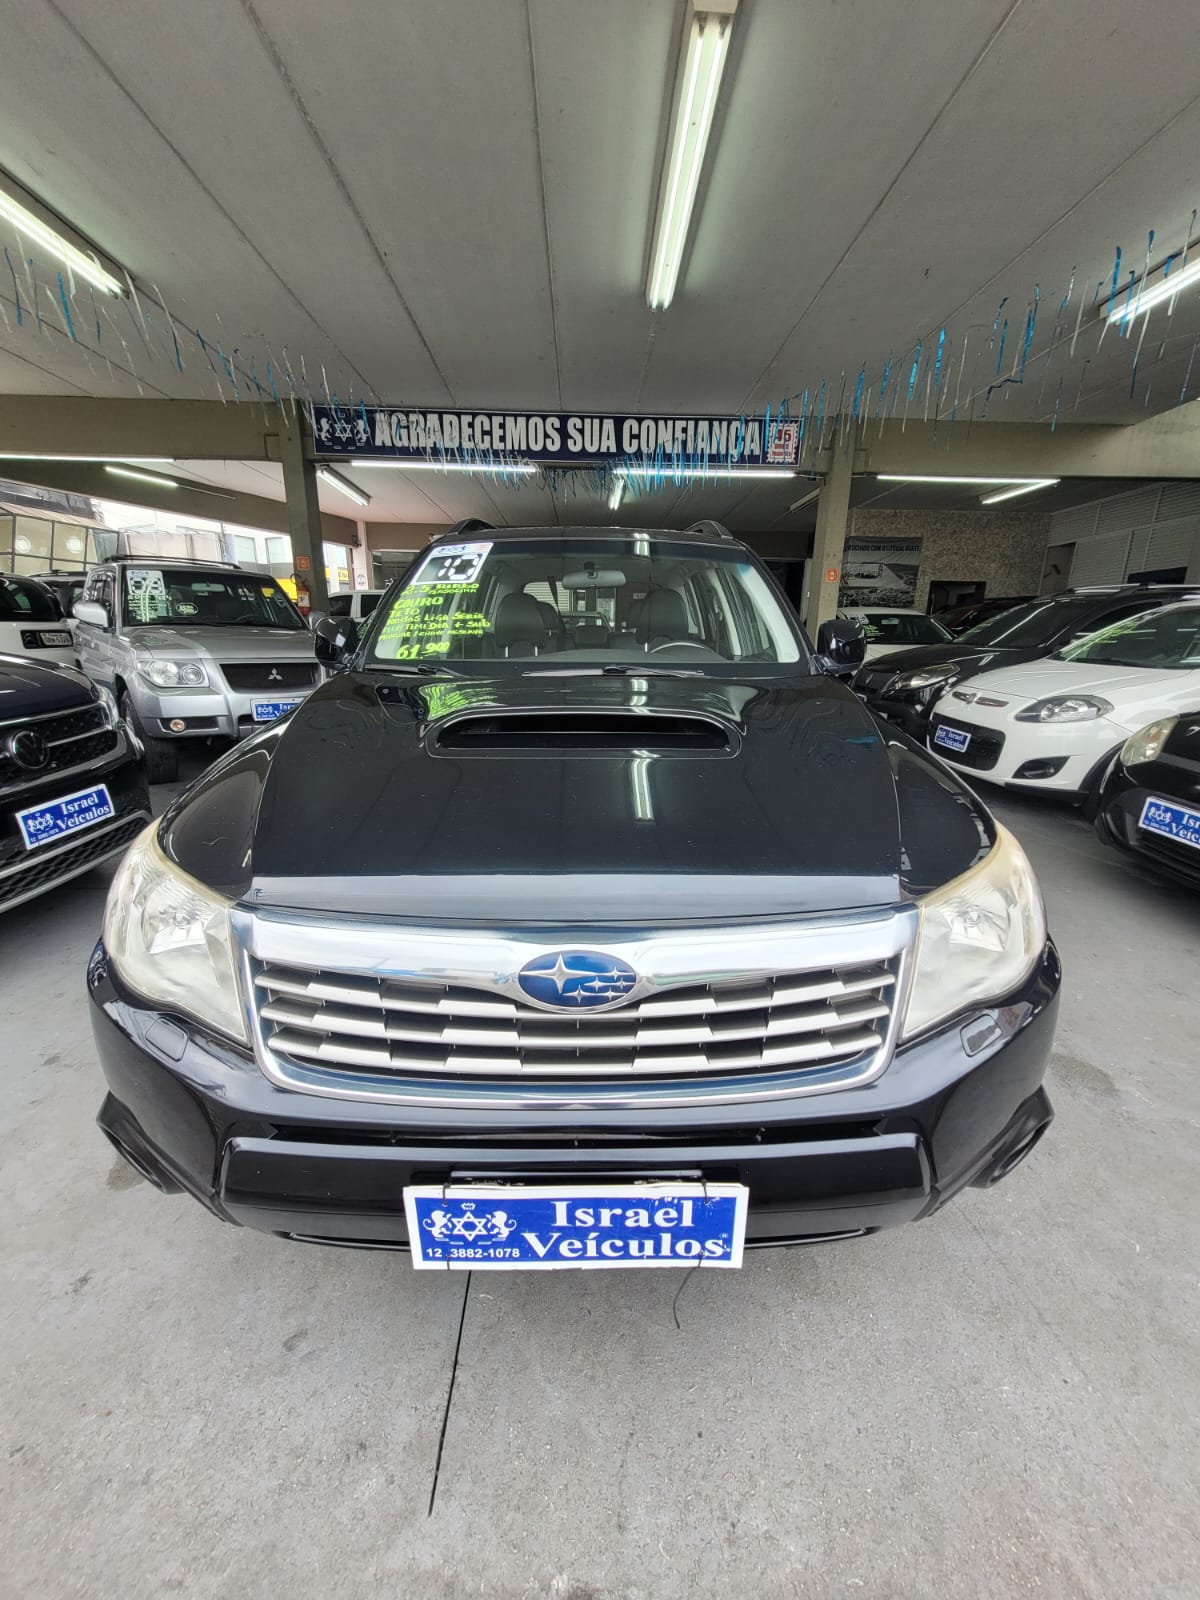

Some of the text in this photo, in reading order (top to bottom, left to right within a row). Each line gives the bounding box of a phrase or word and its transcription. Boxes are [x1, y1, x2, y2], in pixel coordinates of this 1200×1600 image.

[375, 412, 760, 462] AGRADECEMOS SUA CONFIANÇA
[60, 792, 99, 815] Israel
[56, 804, 110, 830] Veículos
[551, 1199, 696, 1228] Israel
[426, 1247, 521, 1259] 12 3882-1078
[520, 1232, 724, 1259] Veículos
